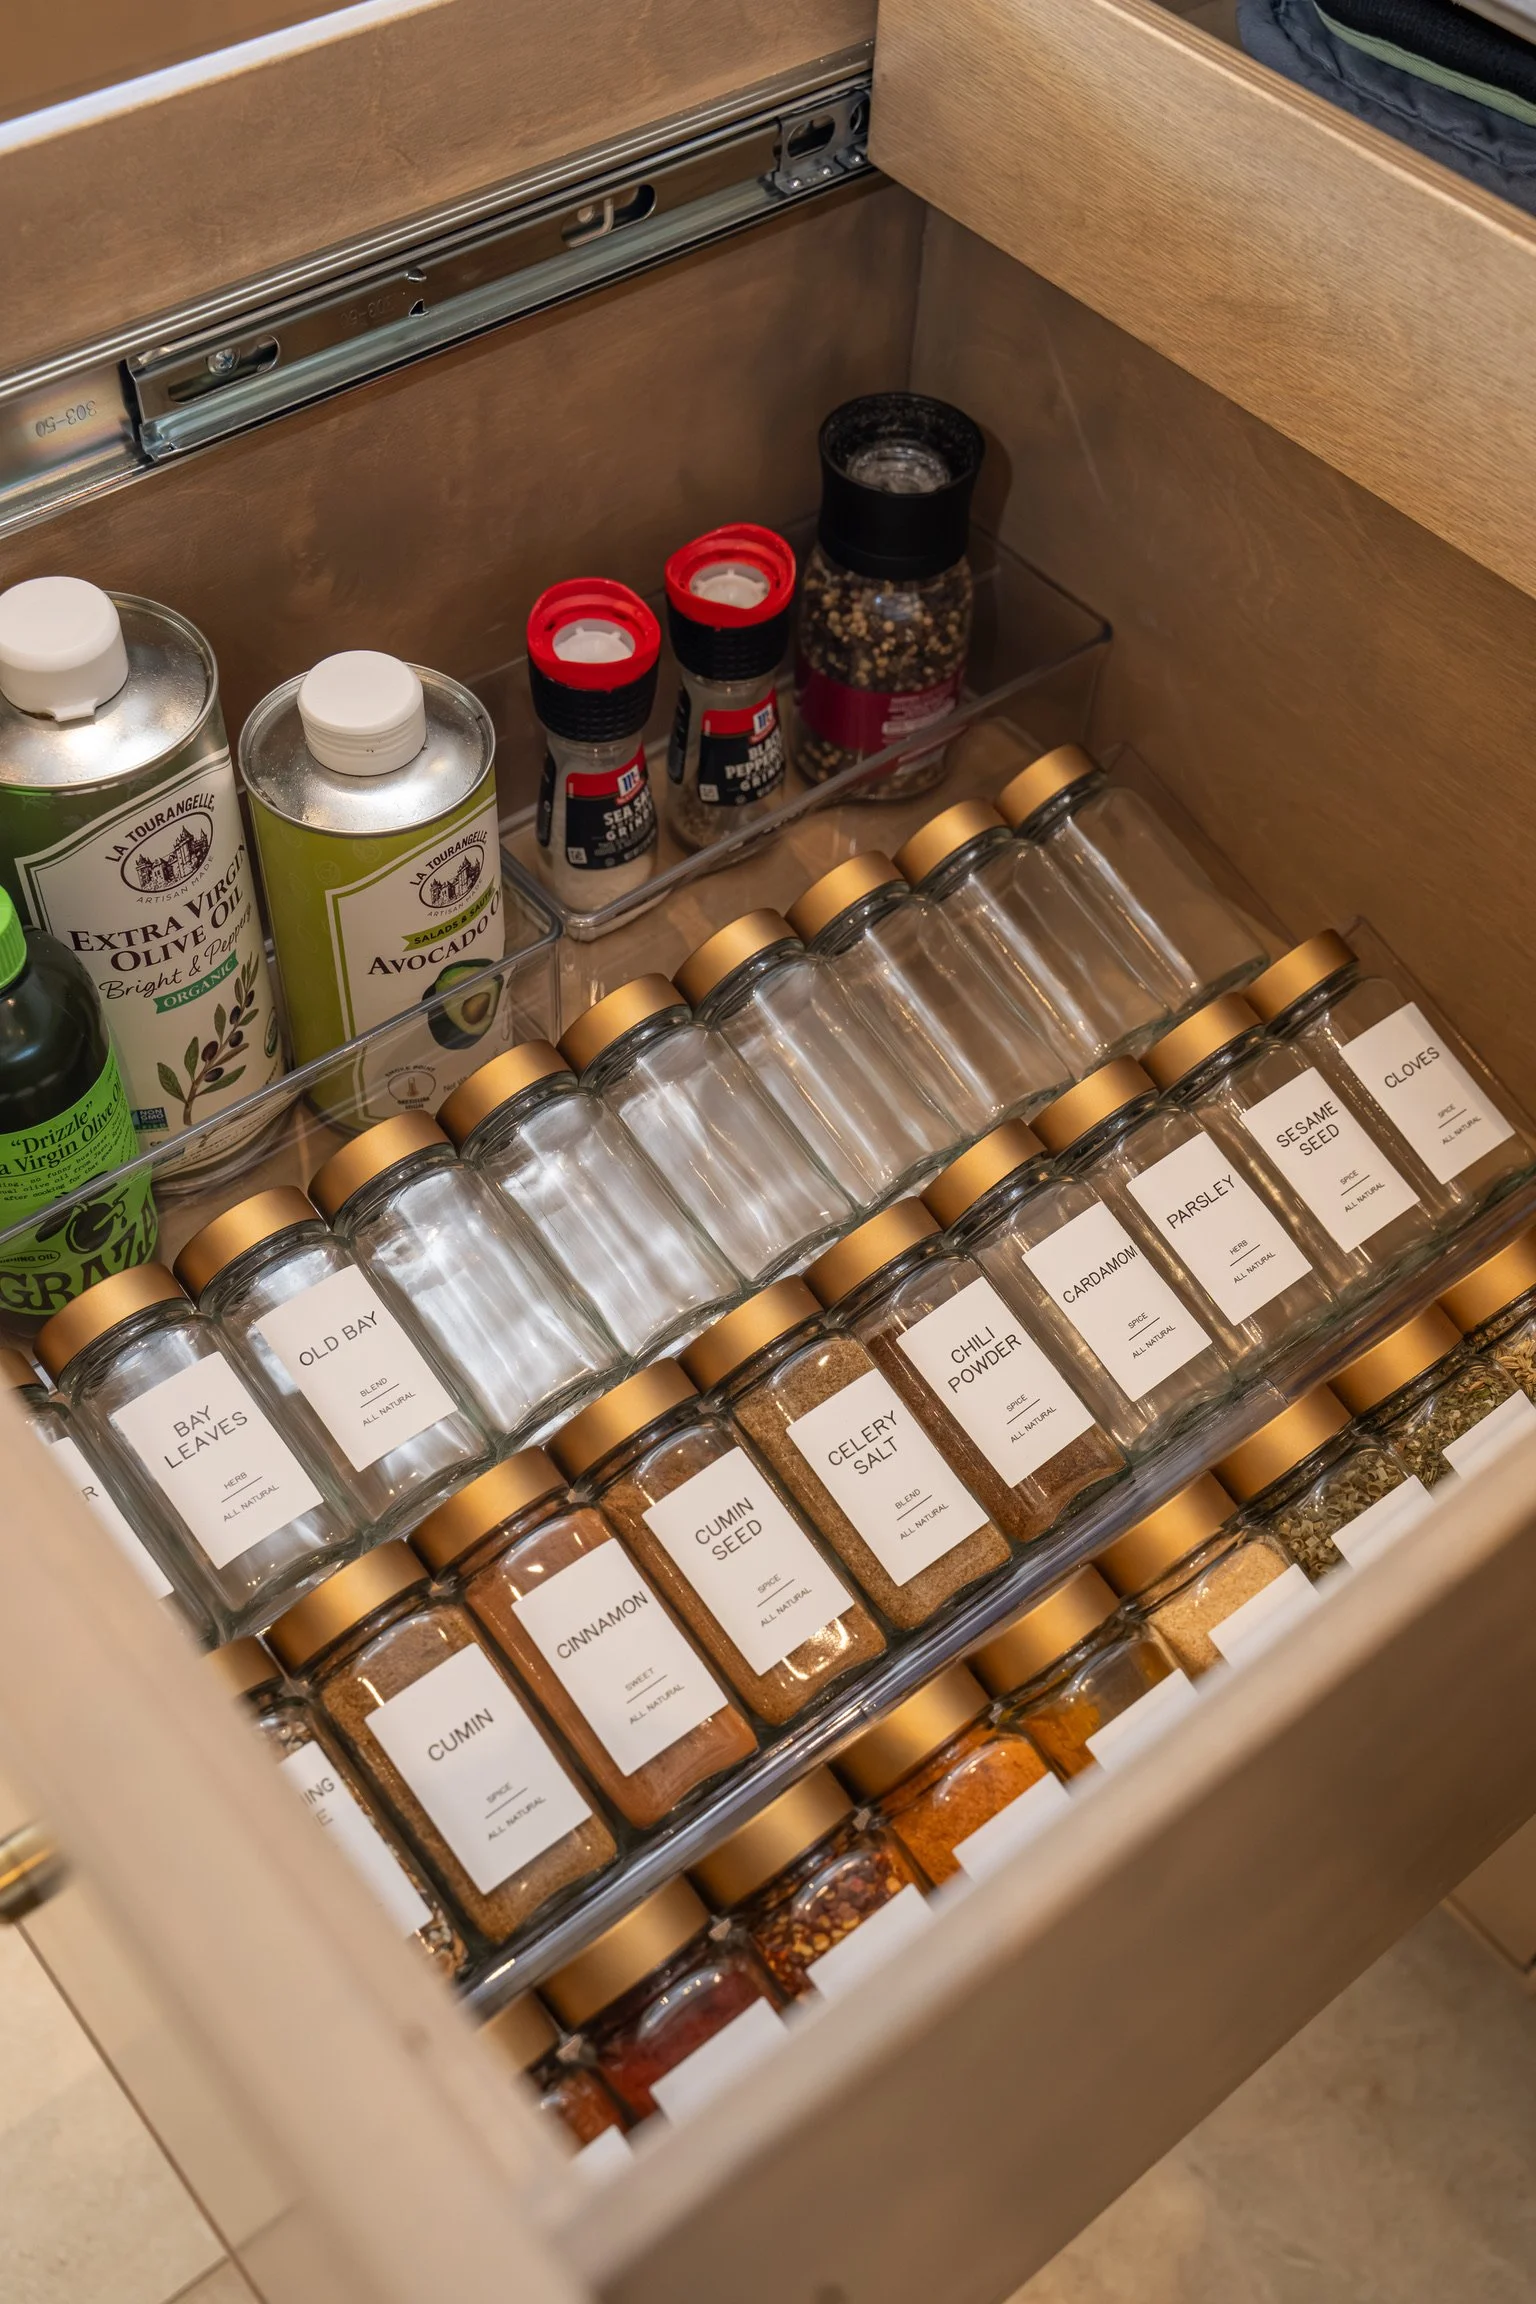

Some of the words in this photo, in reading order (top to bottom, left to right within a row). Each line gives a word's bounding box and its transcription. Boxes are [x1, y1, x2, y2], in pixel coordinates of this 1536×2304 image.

[35, 400, 98, 438] 303-50
[105, 844, 129, 862] LA
[125, 793, 214, 841] TOURANGELLE
[603, 808, 633, 826] SEA
[409, 872, 428, 887] LA
[425, 830, 488, 870] TOURANGELLE
[67, 916, 183, 951] EXTRA
[184, 844, 246, 919] VIRGIN
[136, 886, 188, 904] ARTISAN
[191, 855, 214, 887] MADE
[427, 902, 464, 917] ARTISAN
[466, 879, 483, 903] MADE
[111, 925, 206, 972] OLIVE
[211, 884, 244, 929] OIL
[367, 916, 489, 976] AVOCADO
[414, 920, 459, 945] SALADS
[461, 913, 468, 925] &
[98, 968, 182, 999] Bright
[188, 956, 201, 976] &
[203, 903, 251, 965] Peppery
[163, 961, 235, 1008] ORGANIC
[1384, 1046, 1440, 1089] CLOVES
[1276, 1100, 1339, 1148] SESAME
[1437, 1103, 1456, 1119] SPICE
[14, 1141, 78, 1172] Virgin
[82, 1102, 113, 1142] Olive
[1299, 1123, 1340, 1156] SEED
[1441, 1133, 1455, 1145] ALL
[1454, 1116, 1482, 1136] NATURAL
[4, 1193, 28, 1201] after
[33, 1184, 65, 1197] cooking
[68, 1175, 81, 1184] for
[23, 1182, 50, 1192] olive
[54, 1174, 69, 1182] oil
[73, 1162, 92, 1173] from
[47, 1165, 72, 1178] funny
[1339, 1169, 1359, 1185] SPICE
[1166, 1174, 1235, 1230] PARSLEY
[1344, 1201, 1358, 1213] ALL
[1357, 1181, 1385, 1203] NATURAL
[38, 1253, 56, 1262] OIL
[1229, 1239, 1248, 1255] HERB
[1062, 1245, 1139, 1304] CARDAMOM
[1233, 1272, 1248, 1284] ALL
[1246, 1251, 1276, 1273] NATURAL
[299, 1336, 339, 1366] OLD
[341, 1311, 378, 1341] BAY
[1127, 1312, 1149, 1330] SPICE
[951, 1326, 995, 1364] CHILI
[1132, 1346, 1147, 1359] ALL
[1145, 1324, 1176, 1348] NATURAL
[947, 1333, 1022, 1394] POWDER
[360, 1377, 388, 1397] BLEND
[1006, 1393, 1028, 1412] SPICE
[173, 1405, 212, 1438] BAY
[362, 1414, 380, 1427] ALL
[379, 1391, 416, 1416] NATURAL
[1010, 1430, 1025, 1444] ALL
[1024, 1406, 1057, 1432] NATURAL
[164, 1411, 248, 1469] LEAVES
[828, 1410, 898, 1466] CELERY
[853, 1436, 898, 1475] SALT
[223, 1471, 248, 1490] HERB
[894, 1488, 921, 1510] BLEND
[223, 1509, 241, 1522] ALL
[240, 1484, 280, 1510] NATURAL
[695, 1497, 755, 1545] CUMIN
[899, 1528, 916, 1541] ALL
[914, 1502, 950, 1529] NATURAL
[712, 1519, 763, 1561] SEED
[757, 1573, 781, 1594] SPICE
[556, 1591, 649, 1659] CINNAMON
[760, 1614, 777, 1628] ALL
[776, 1587, 812, 1615] NATURAL
[625, 1667, 655, 1692] SWEET
[629, 1711, 647, 1725] ALL
[646, 1684, 685, 1712] NATURAL
[427, 1708, 494, 1762] CUMIN
[486, 1782, 512, 1804] SPICE
[488, 1827, 507, 1841] ALL
[506, 1796, 547, 1827] NATURAL
